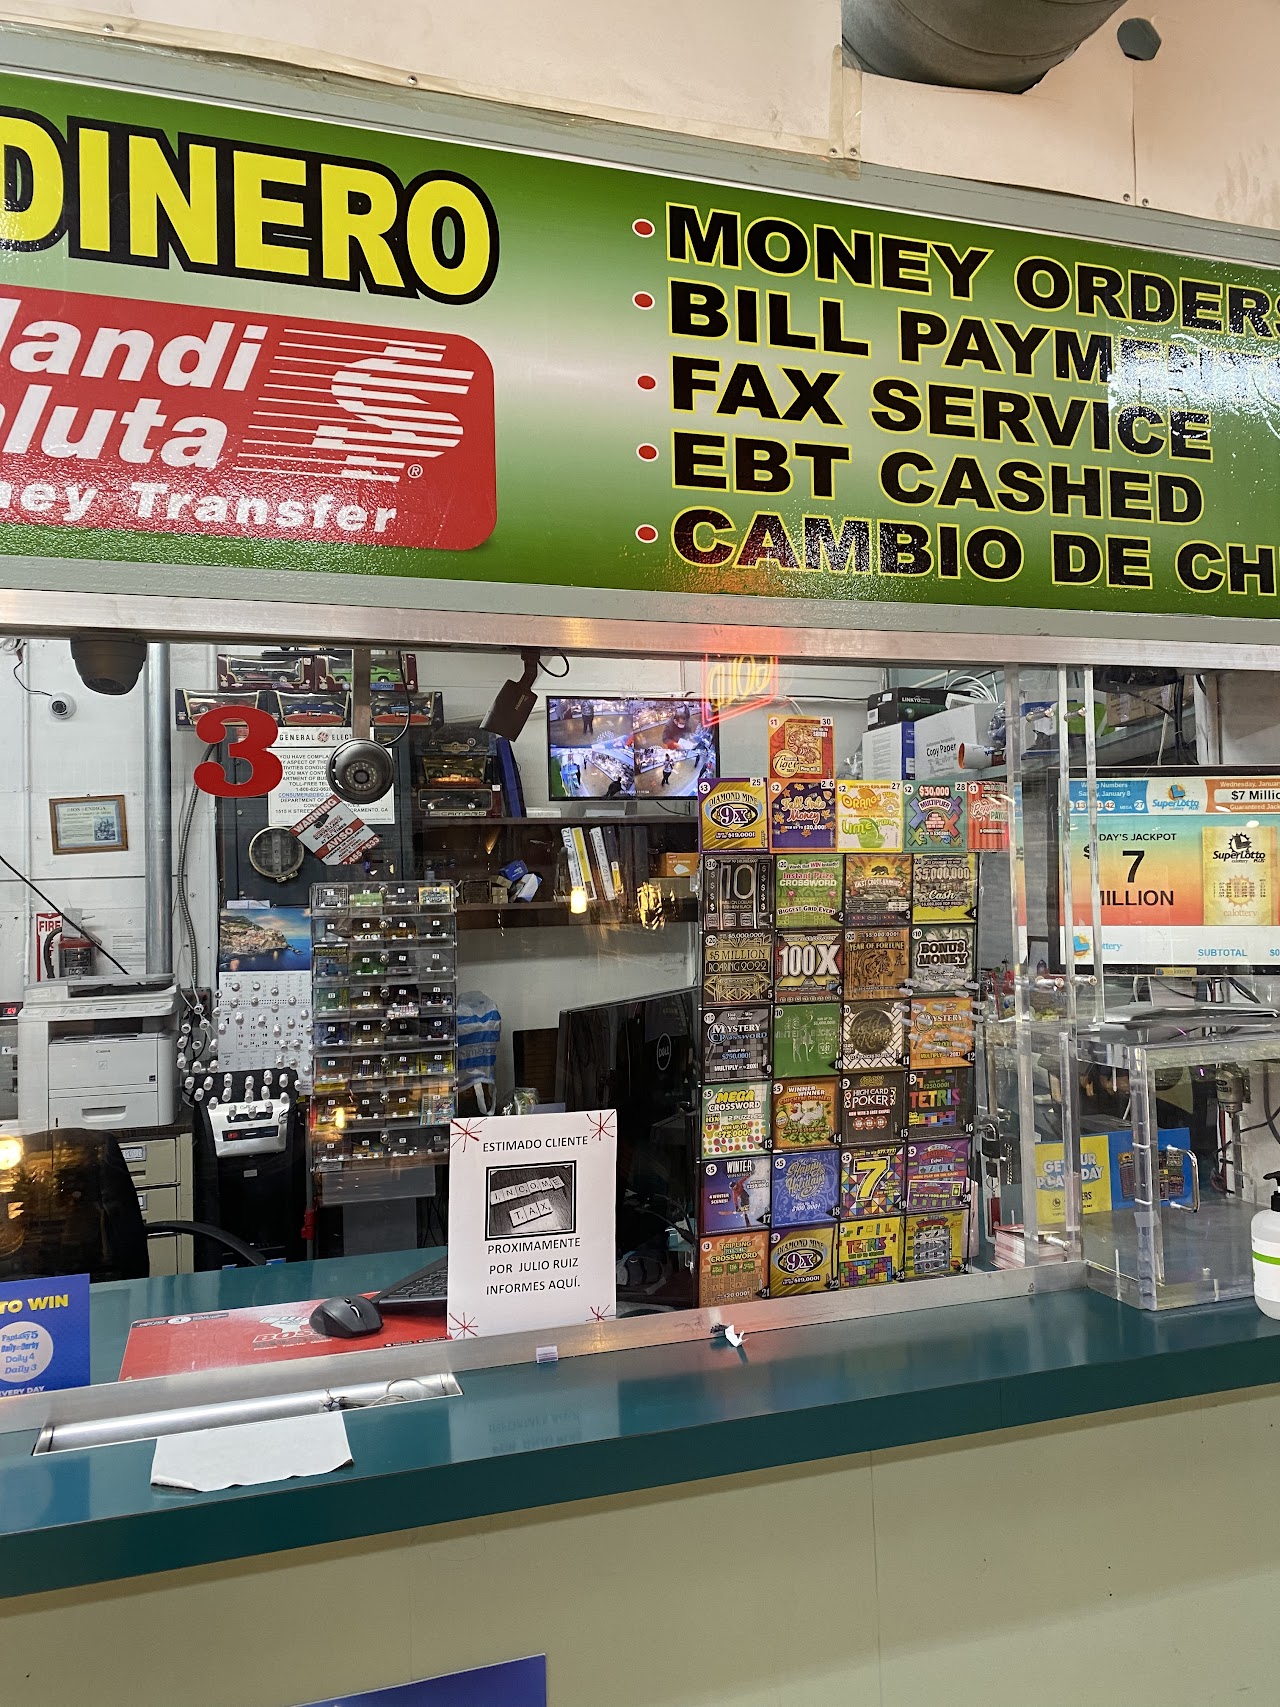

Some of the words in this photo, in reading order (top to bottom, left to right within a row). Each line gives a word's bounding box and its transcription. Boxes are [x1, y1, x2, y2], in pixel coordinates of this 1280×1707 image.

[0, 107, 499, 305] DINERO
[665, 202, 994, 300] MONEY
[1014, 256, 1280, 341] ORDER
[668, 277, 871, 359] BILL
[670, 354, 847, 428] FAX
[870, 377, 1213, 464] SERVICE
[0, 384, 228, 470] luta
[671, 431, 851, 501] EBT
[878, 450, 1204, 525] CASHED
[131, 482, 396, 532] Transfer
[671, 507, 1024, 584] CAMBIO
[1052, 530, 1152, 591] DE
[1176, 542, 1280, 596] CH
[822, 718, 831, 726] 30
[279, 734, 315, 742] GENERAL
[194, 706, 283, 797] 3
[926, 747, 940, 758] Copy
[940, 743, 957, 754] Paper
[700, 784, 709, 792] $3
[891, 782, 901, 790] 27
[918, 786, 950, 797] $30,000
[956, 783, 966, 791] 28
[709, 792, 741, 807] DIAMOND
[1231, 790, 1246, 801] $7
[920, 799, 951, 810] MULTIPLIER
[1152, 799, 1200, 809] SuperLotto
[294, 798, 338, 833] WARNING
[786, 810, 821, 825] Money
[327, 827, 354, 852] AVISO
[1098, 833, 1128, 841] DAY'S
[1131, 833, 1177, 841] JACKPOT
[1213, 851, 1266, 862] SuperLotto
[1122, 850, 1145, 884] 7
[784, 872, 812, 880] Instant
[814, 872, 835, 880] Prize
[914, 867, 971, 881] $5,000,000
[929, 890, 955, 900] Cash
[768, 914, 773, 923] 1
[838, 912, 844, 921] 2
[905, 910, 911, 920] 3
[971, 909, 977, 918] 4
[1223, 909, 1257, 917] calottery
[39, 920, 61, 932] FIRE
[849, 943, 866, 951] YEAR
[876, 941, 905, 950] FORTUNE
[709, 951, 720, 960] $5
[721, 949, 767, 960] MILLION
[1198, 949, 1247, 957] SUBTOTAL
[779, 944, 841, 976] 100X
[918, 953, 968, 965] MONEY
[708, 962, 740, 972] ROARING
[741, 961, 767, 971] 2022
[767, 989, 773, 998] 5
[836, 986, 842, 995] 6
[712, 1023, 761, 1033] MYSTERY
[903, 1056, 910, 1065] 11
[967, 1052, 974, 1060] 12
[766, 1064, 772, 1074] 9
[834, 1060, 843, 1069] 10
[773, 1084, 782, 1092] $5
[788, 1085, 816, 1093] WINNER
[853, 1088, 870, 1096] HIGH
[703, 1090, 712, 1098] $5
[715, 1090, 755, 1104] MEGA
[909, 1088, 960, 1108] TETRIS
[708, 1101, 761, 1112] CROSSWORD
[852, 1094, 888, 1108] POKER
[718, 1128, 752, 1138] $75,000!
[900, 1128, 909, 1138] 15
[965, 1123, 973, 1133] 16
[483, 1139, 542, 1153] ESTIMADO
[545, 1135, 588, 1149] CLIENTE
[833, 1134, 842, 1143] 14
[764, 1140, 773, 1149] 13
[707, 1166, 716, 1174] $5
[727, 1160, 753, 1174] WINTER
[787, 1161, 826, 1178] Happy
[854, 1156, 890, 1202] 7
[492, 1176, 562, 1200] INCOME
[963, 1194, 971, 1202] 20
[899, 1201, 906, 1209] 19
[513, 1202, 551, 1221] TAX
[832, 1207, 840, 1216] 18
[763, 1214, 771, 1223] 17
[487, 1237, 581, 1255] PROXIMAMENTE
[719, 1241, 752, 1250] TRIPLING
[777, 1240, 808, 1256] DIAMOND
[846, 1237, 887, 1254] TETRIS
[710, 1252, 758, 1263] CROSSWORD
[489, 1264, 513, 1275] POR
[519, 1260, 550, 1273] JULIO
[553, 1257, 579, 1270] RUIZ
[896, 1271, 905, 1280] 23
[486, 1281, 546, 1296] INFORMES
[548, 1277, 581, 1291] AQUÍ.
[829, 1279, 839, 1289] 22
[761, 1288, 770, 1297] 21
[0, 1299, 23, 1315] TO
[28, 1294, 69, 1312] WIN
[2, 1332, 30, 1342] Fantasy
[31, 1331, 39, 1339] 5
[6, 1354, 28, 1364] Daily
[29, 1352, 35, 1360] 4
[5, 1365, 30, 1375] Daily
[26, 1386, 45, 1394] DAY
